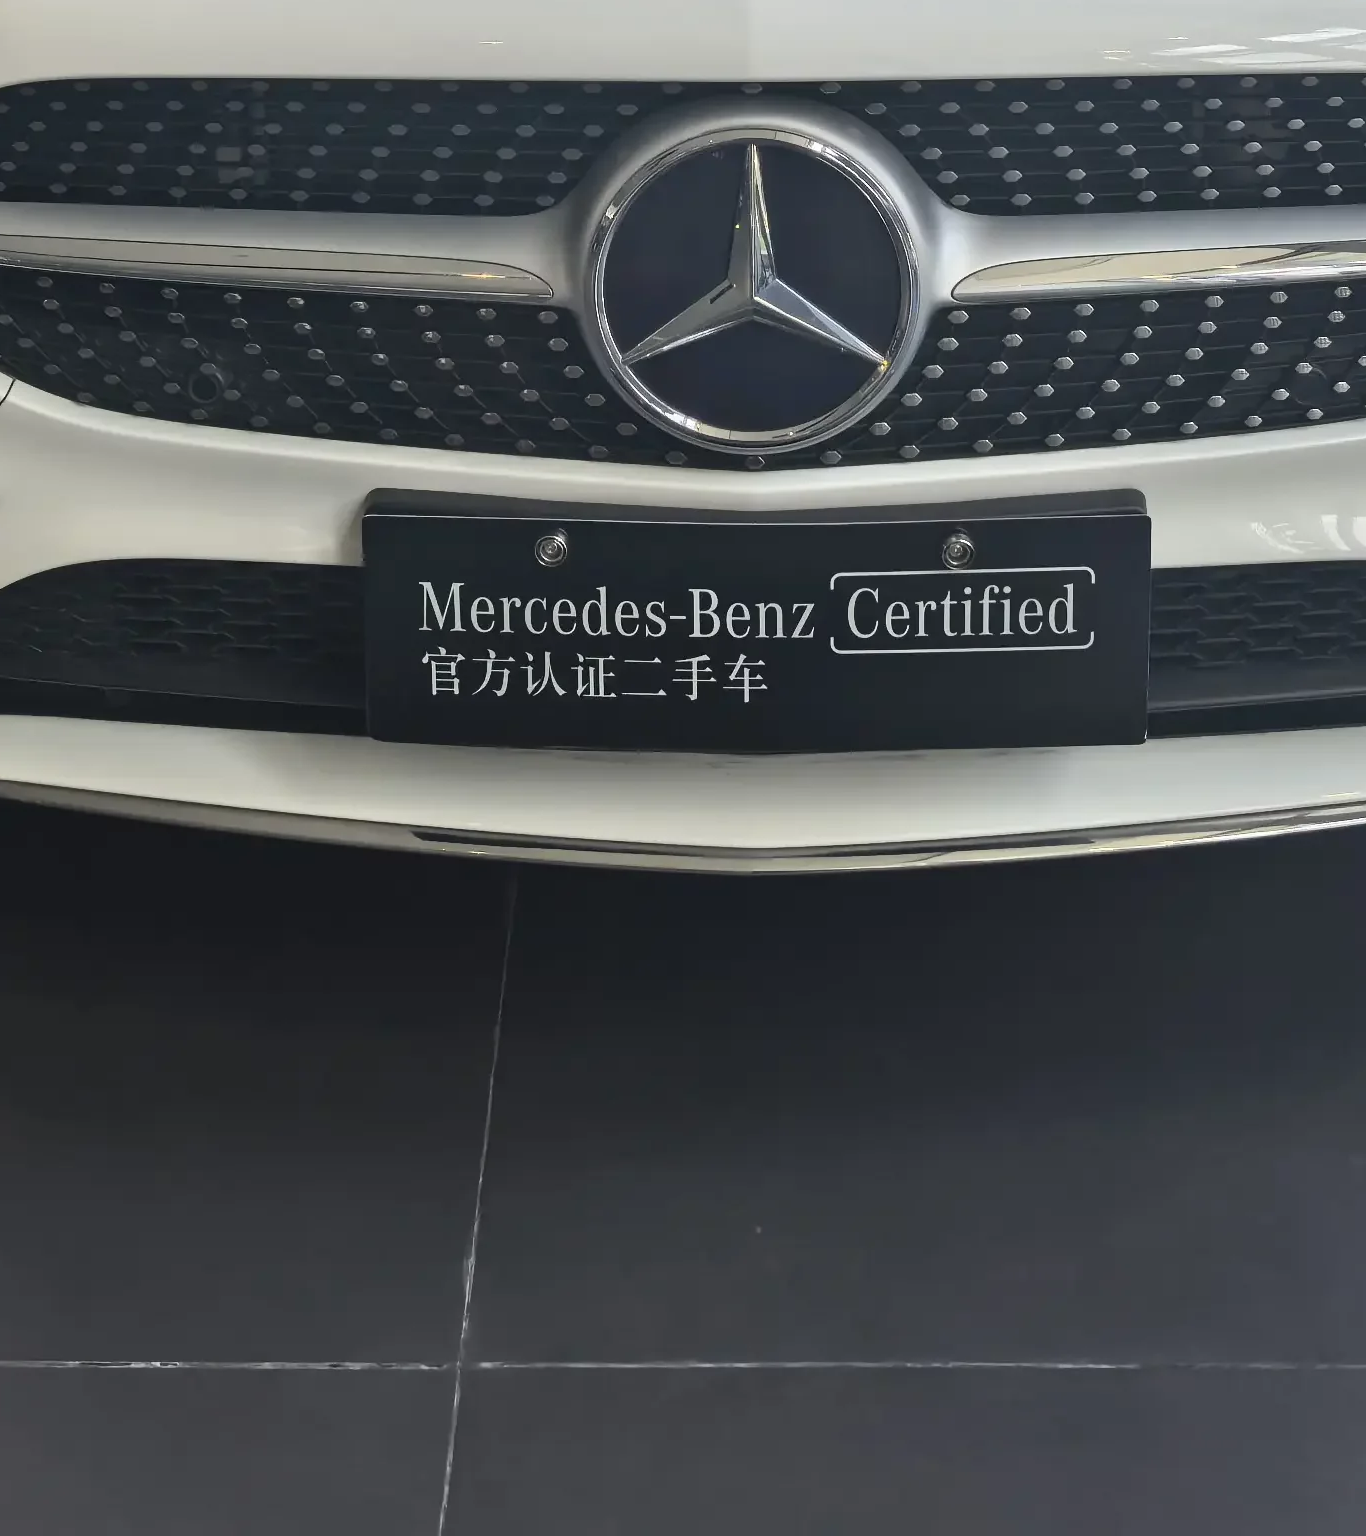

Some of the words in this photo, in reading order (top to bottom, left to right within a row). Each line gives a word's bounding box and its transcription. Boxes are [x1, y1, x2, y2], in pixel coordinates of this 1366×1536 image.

[418, 581, 816, 639] Mercedes-Benz
[847, 583, 1078, 639] Certified
[421, 646, 769, 703] 官方认证二手车
